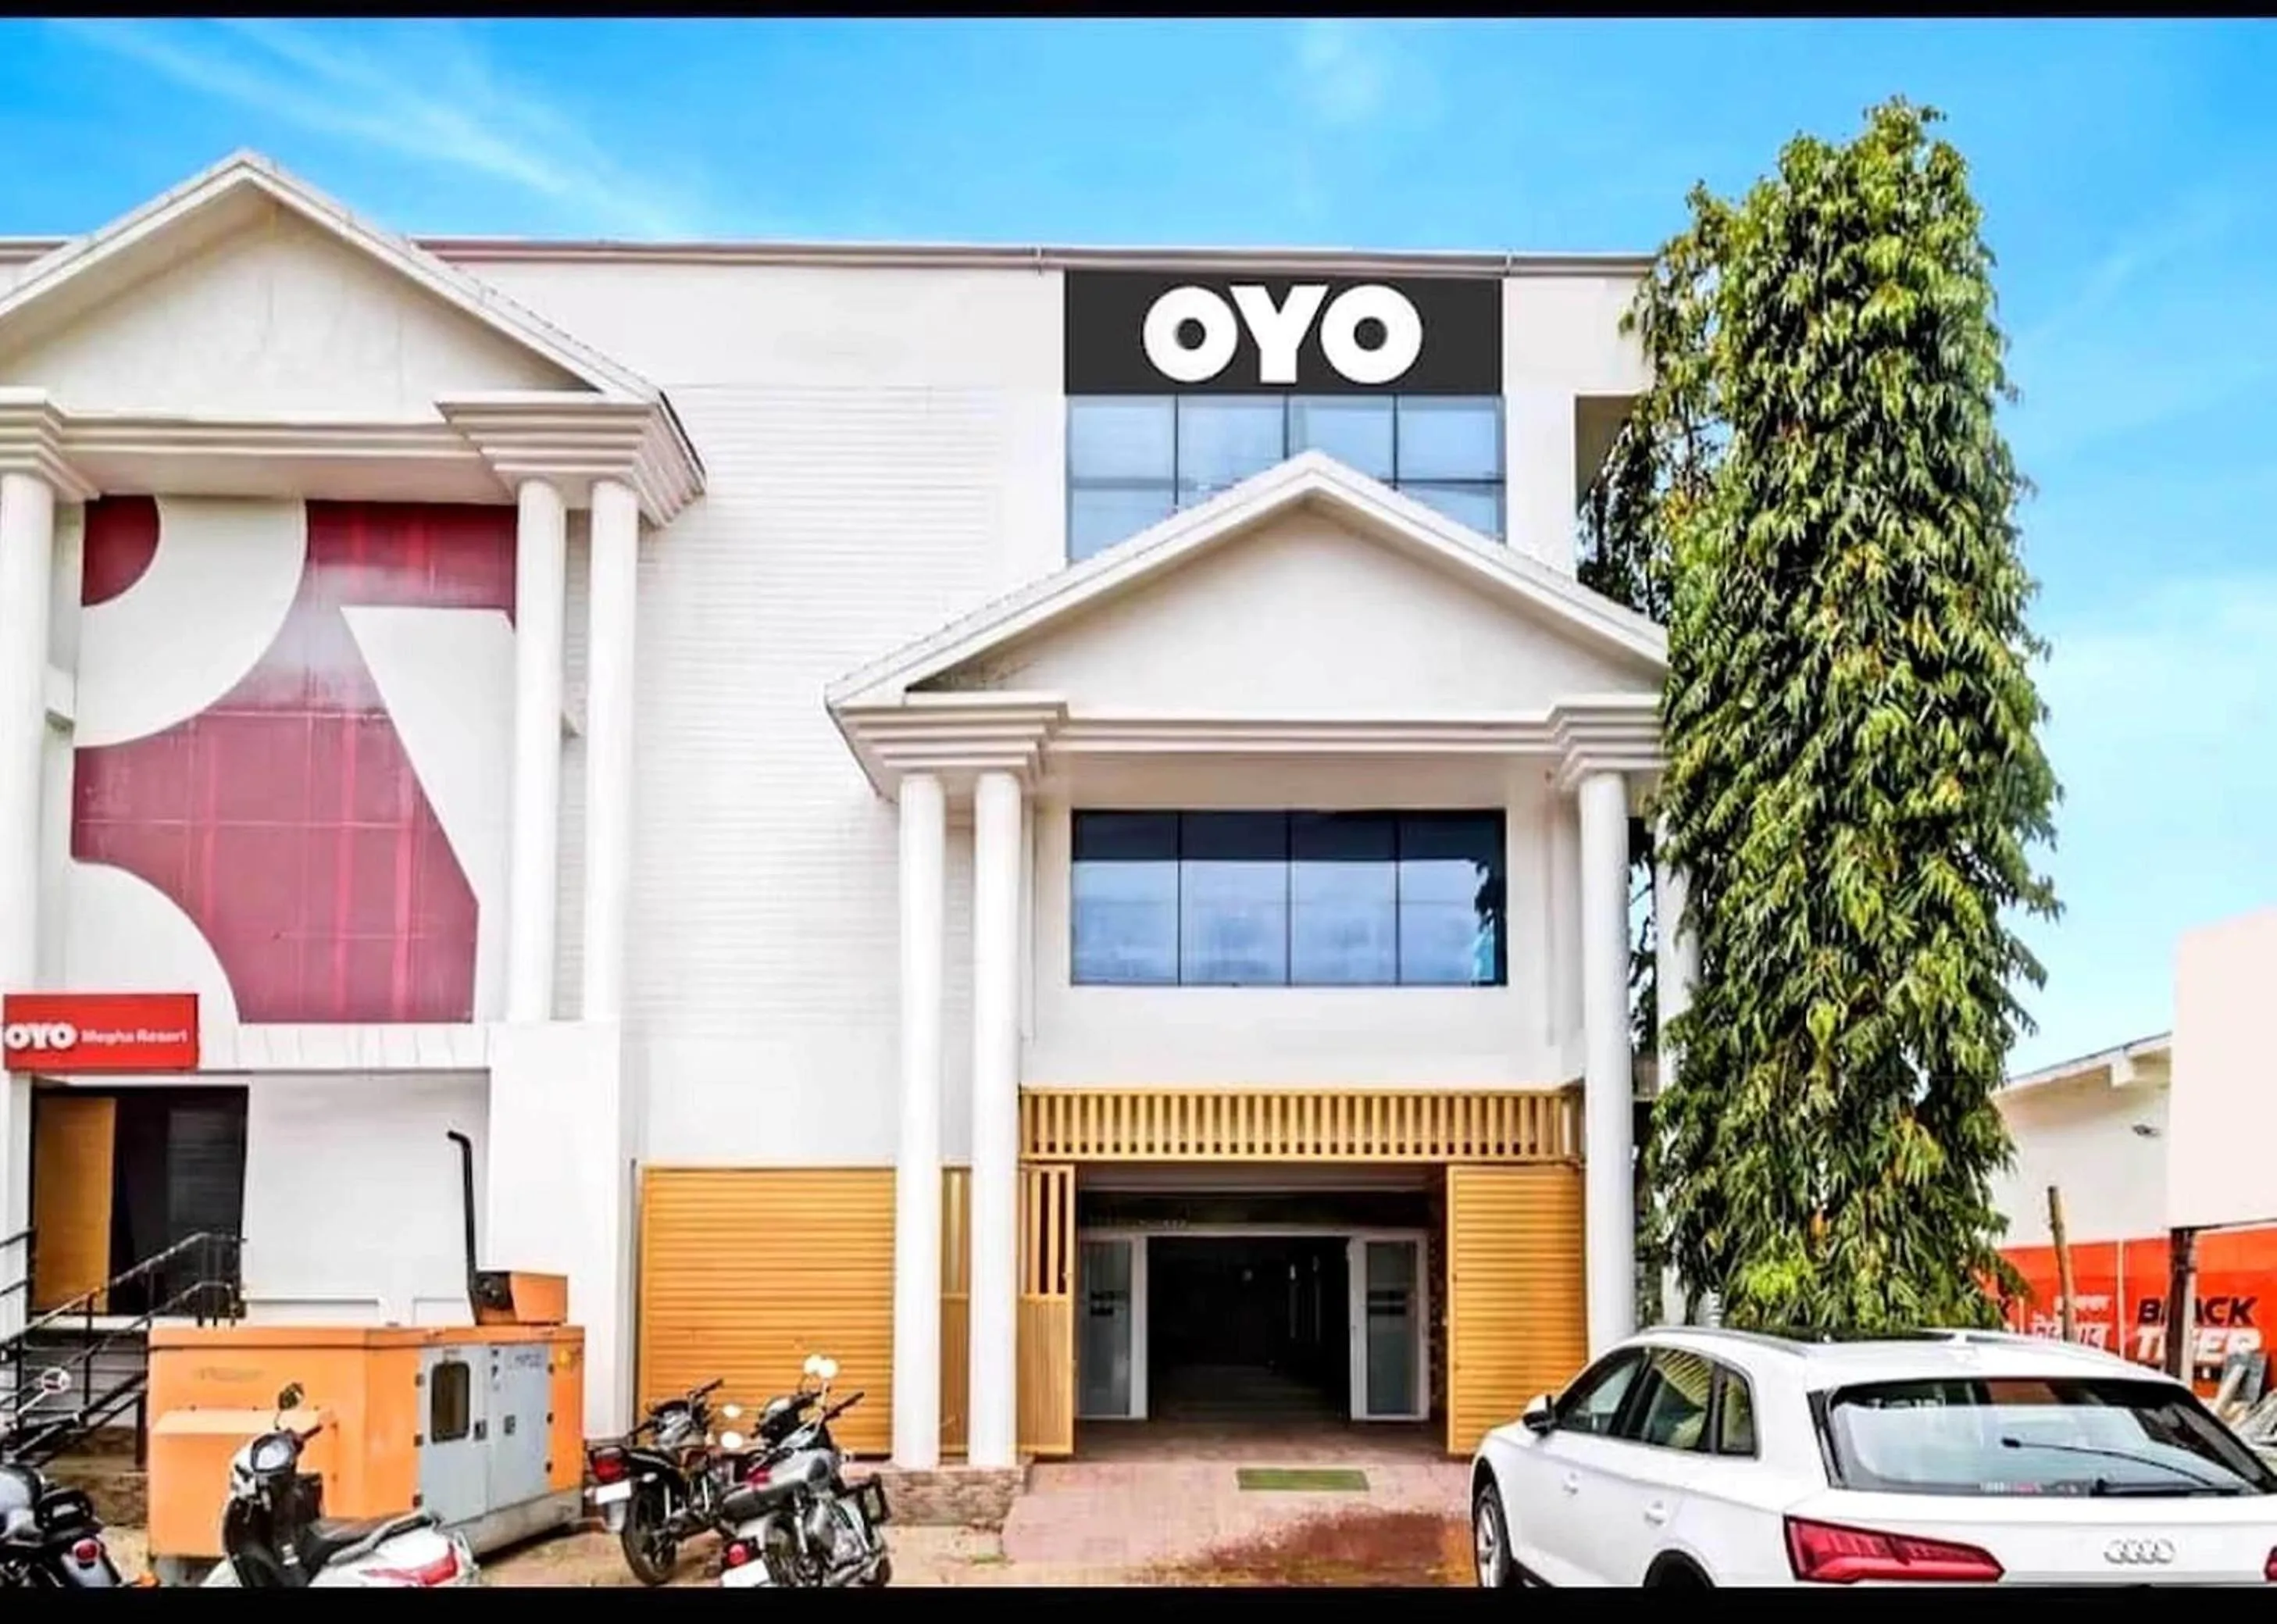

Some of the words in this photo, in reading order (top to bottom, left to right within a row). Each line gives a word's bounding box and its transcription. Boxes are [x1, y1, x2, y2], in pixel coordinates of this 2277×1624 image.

[1143, 284, 1423, 384] OYO
[5, 1023, 77, 1049] OYO
[2137, 1297, 2257, 1326] BCK
[2137, 1326, 2262, 1362] TIER
